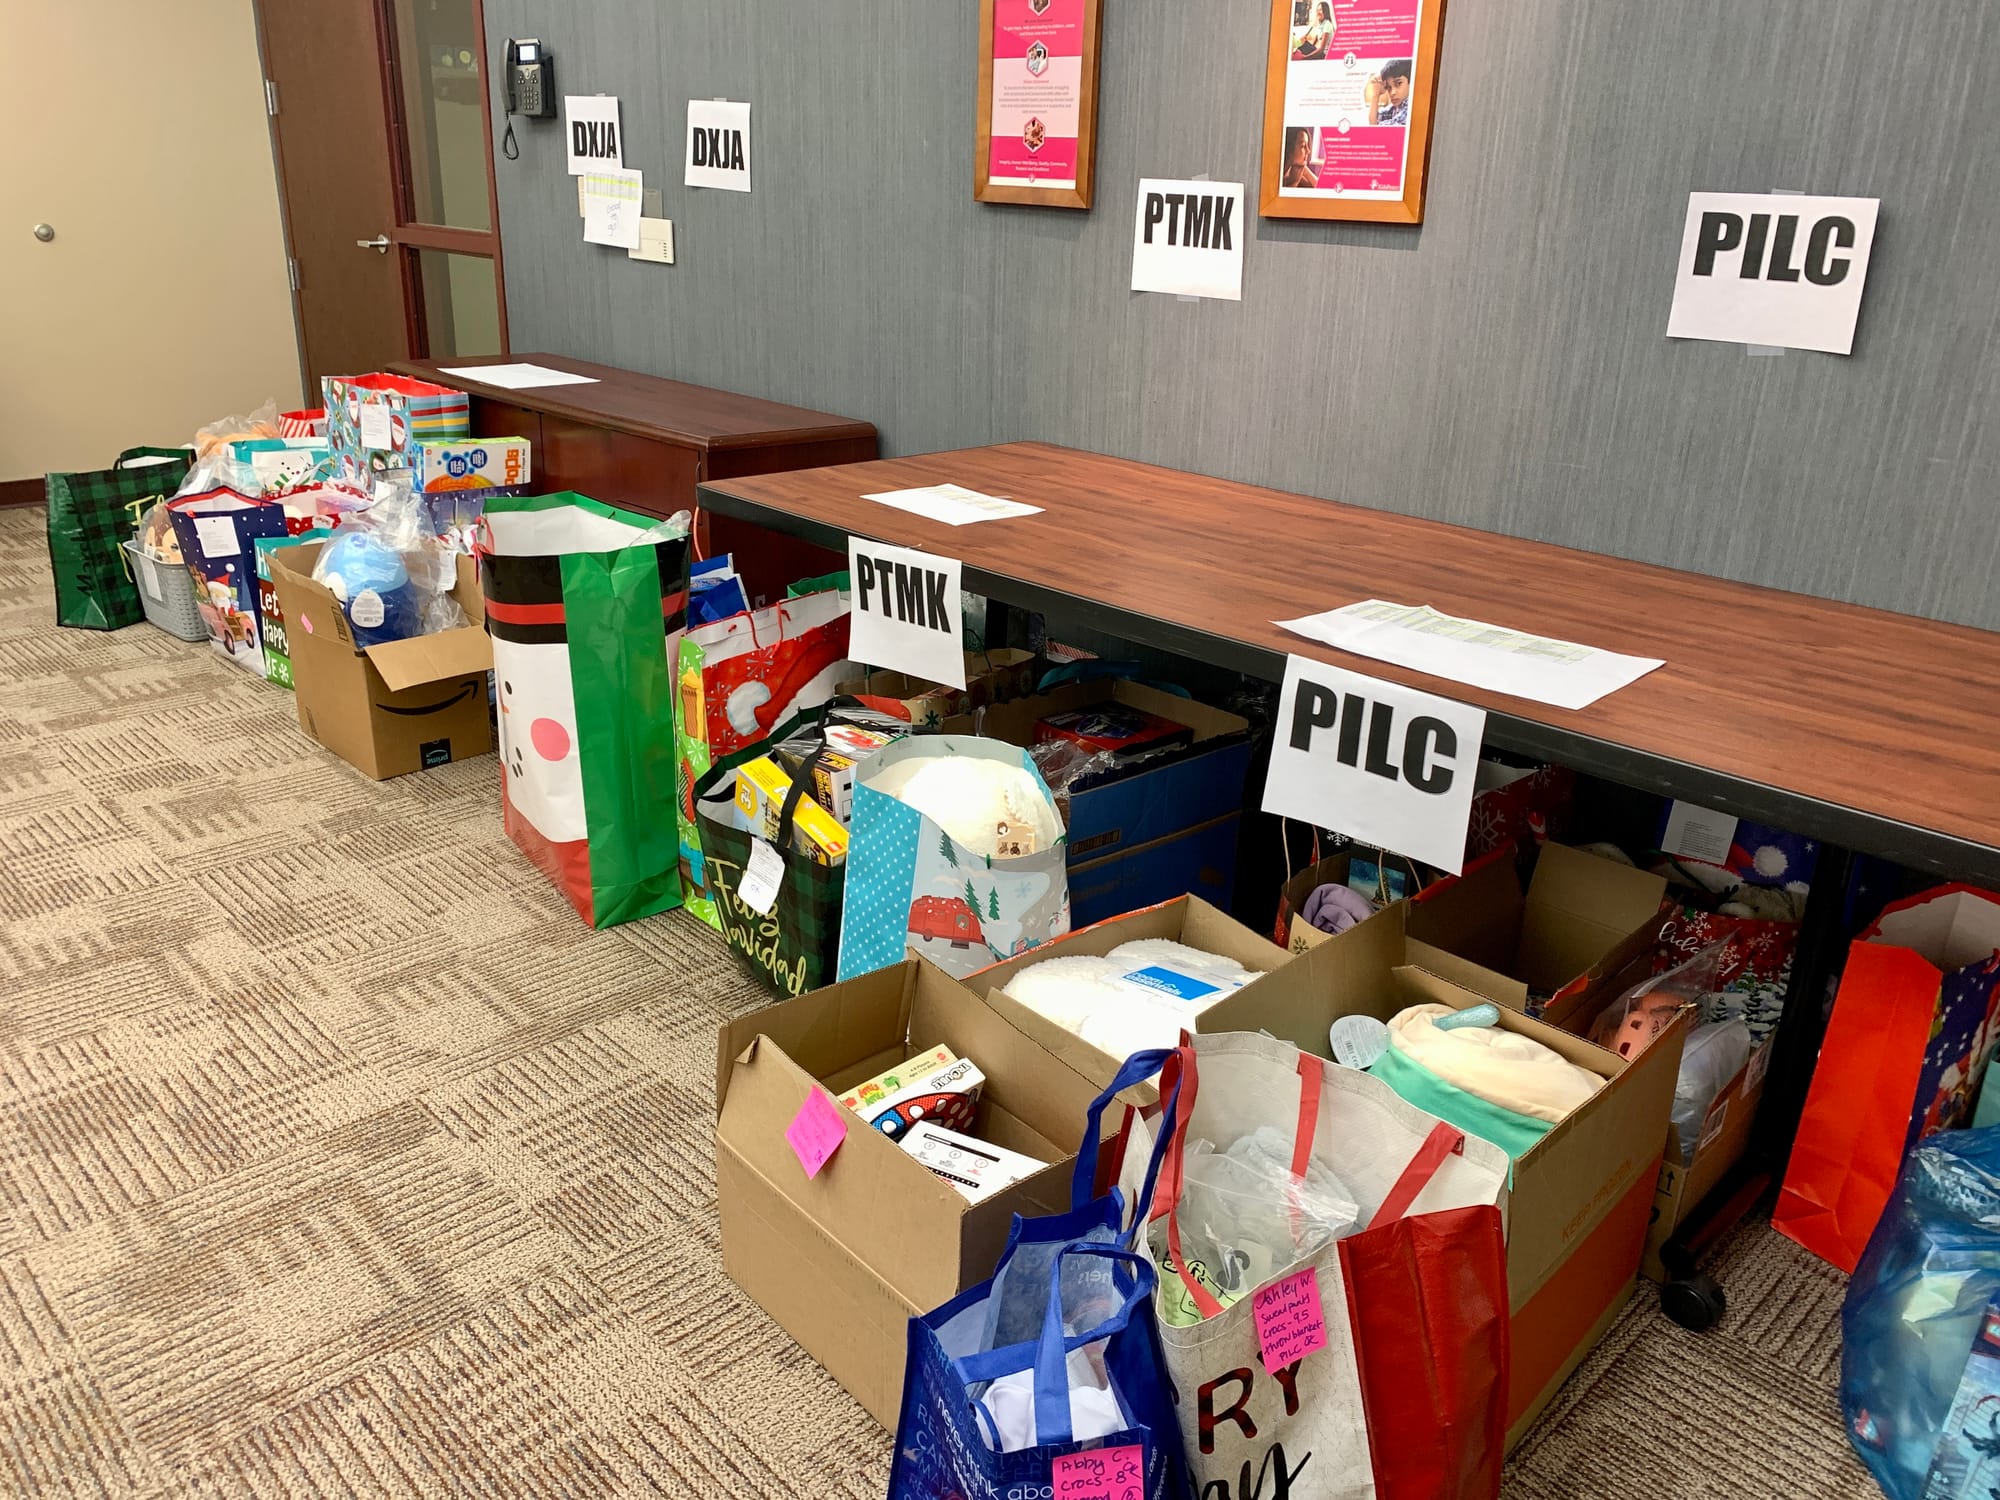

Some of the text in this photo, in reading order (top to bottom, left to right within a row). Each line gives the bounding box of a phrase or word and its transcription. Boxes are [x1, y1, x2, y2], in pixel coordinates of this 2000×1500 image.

[572, 121, 617, 159] DXJA
[692, 127, 745, 171] DXJA
[1143, 192, 1235, 251] PTMK
[1693, 212, 1856, 286] PILC
[260, 589, 279, 616] Let
[856, 553, 952, 634] PTMK
[263, 617, 288, 656] Happy
[1289, 678, 1457, 794] PILC
[1279, 1344, 1302, 1361] PILC
[937, 1396, 1054, 1500] never think abo
[1060, 1457, 1106, 1476] Abby
